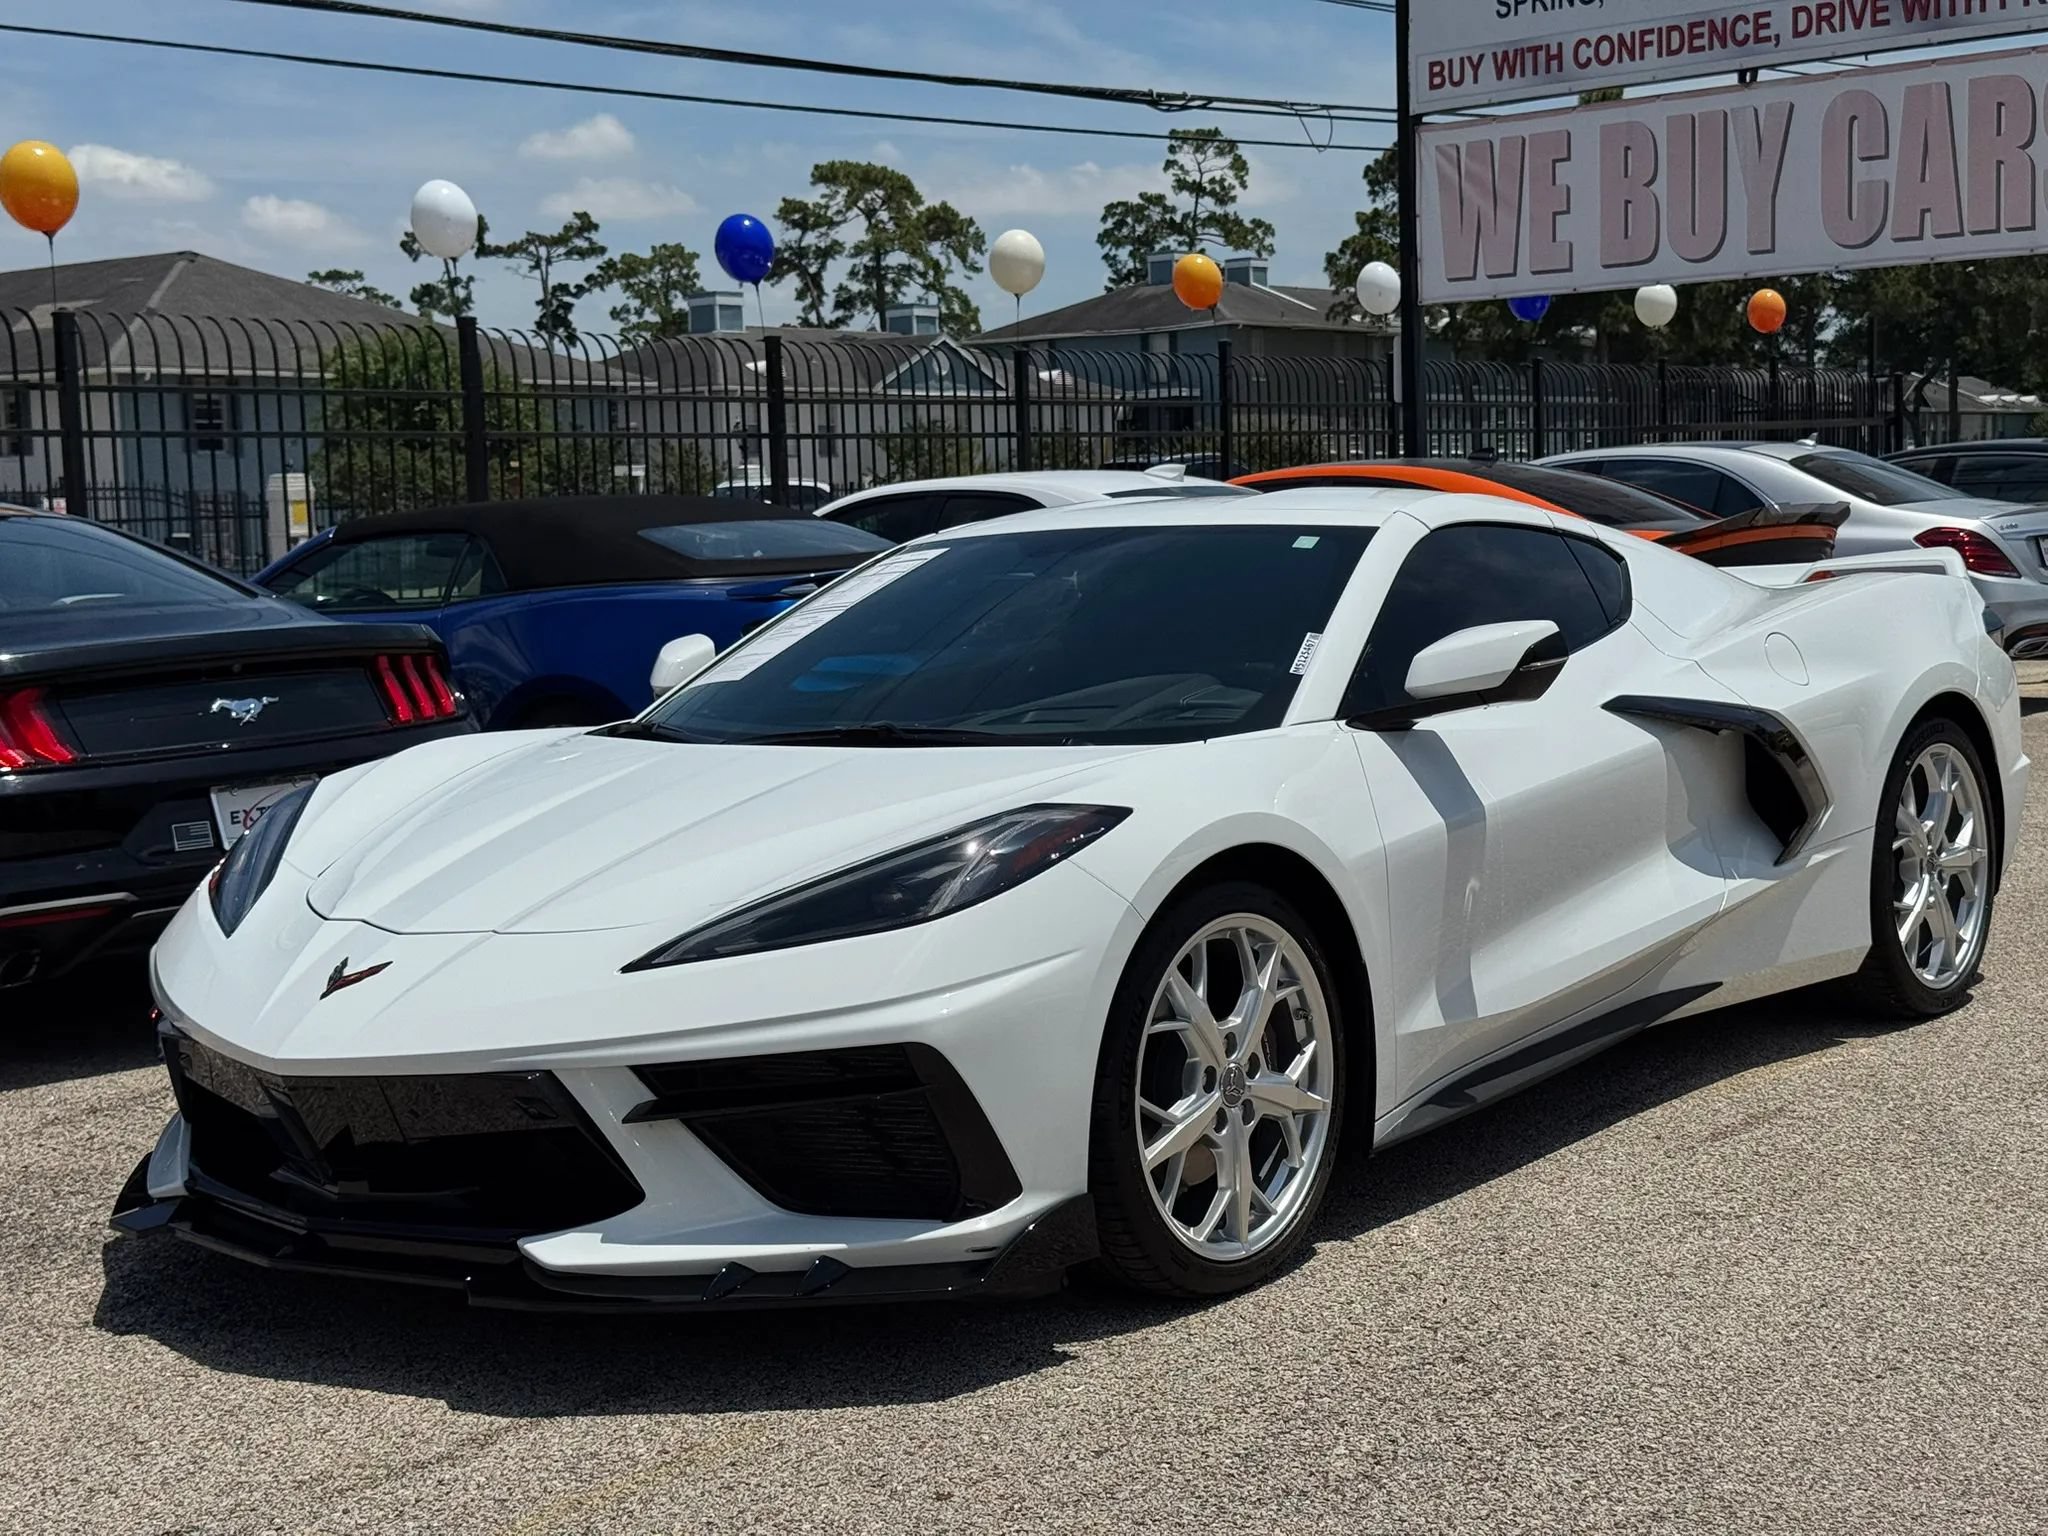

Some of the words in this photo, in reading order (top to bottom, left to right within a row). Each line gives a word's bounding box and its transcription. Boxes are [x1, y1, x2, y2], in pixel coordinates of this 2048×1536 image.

[1428, 53, 1486, 91] BUY
[1492, 42, 1563, 81] WITH
[1572, 10, 1780, 70] CONFIDENCE,
[1792, 0, 1890, 39] DRIVE
[1496, 0, 1604, 19] SPR,
[1435, 129, 1573, 282] WE
[1601, 101, 1794, 268] BUY
[1820, 74, 2048, 249] CAR
